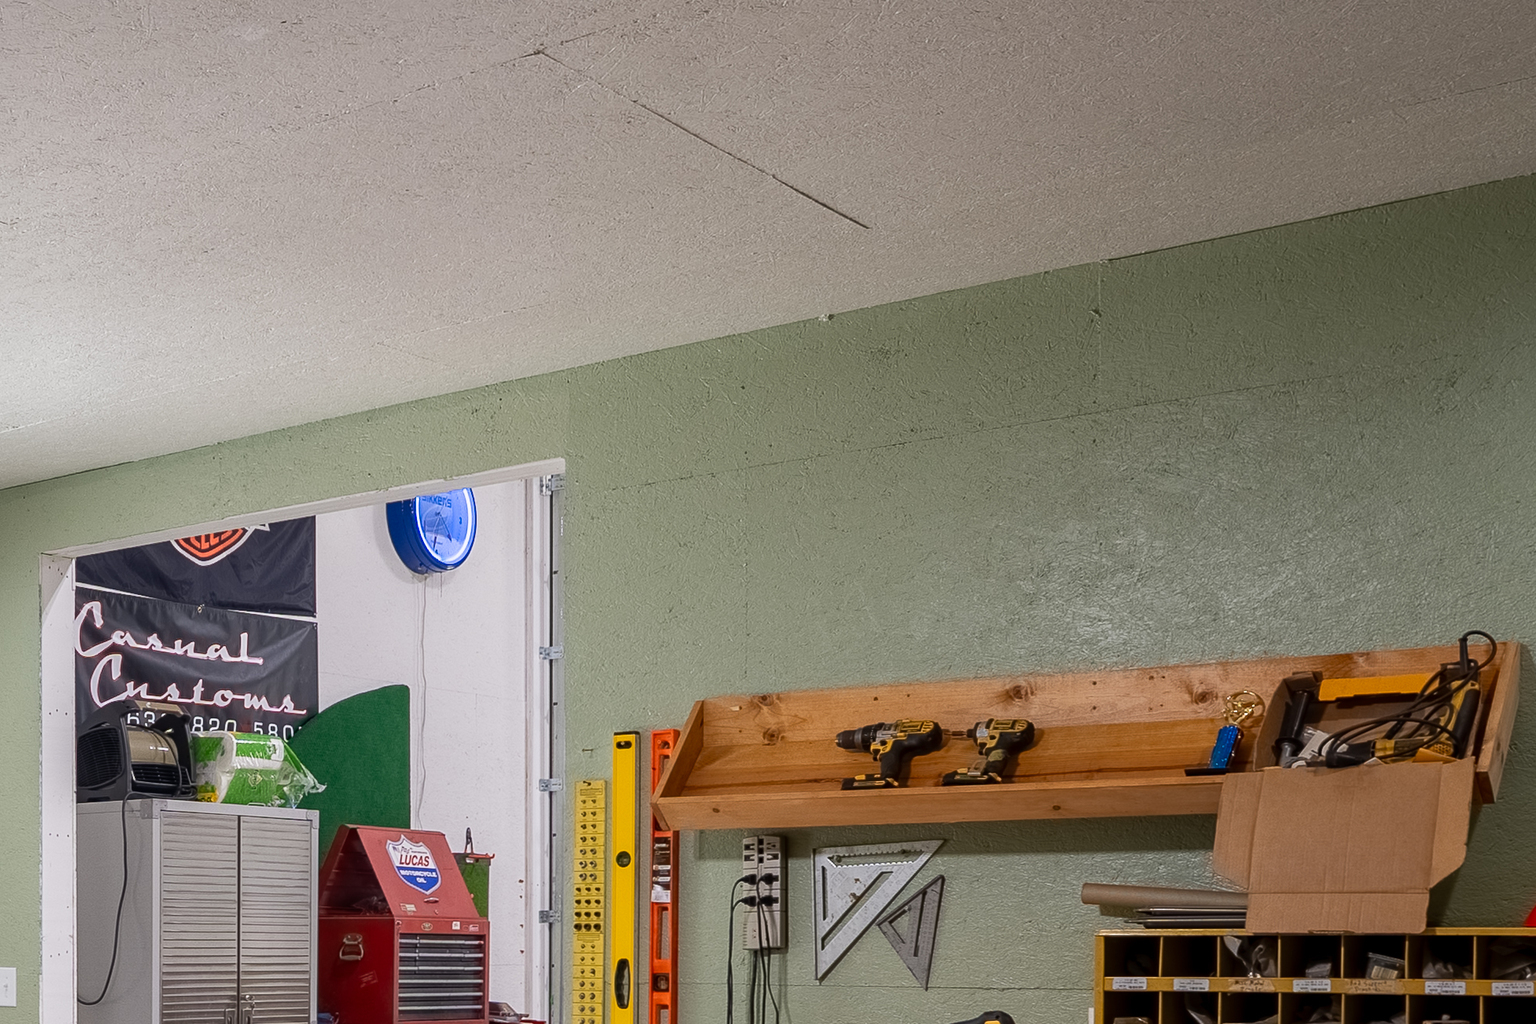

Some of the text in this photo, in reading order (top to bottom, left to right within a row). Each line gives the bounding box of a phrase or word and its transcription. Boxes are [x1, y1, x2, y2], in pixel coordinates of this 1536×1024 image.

[74, 601, 264, 666] Casual
[90, 654, 307, 715] Customs
[253, 721, 302, 742] 580
[399, 854, 430, 867] LUCAS
